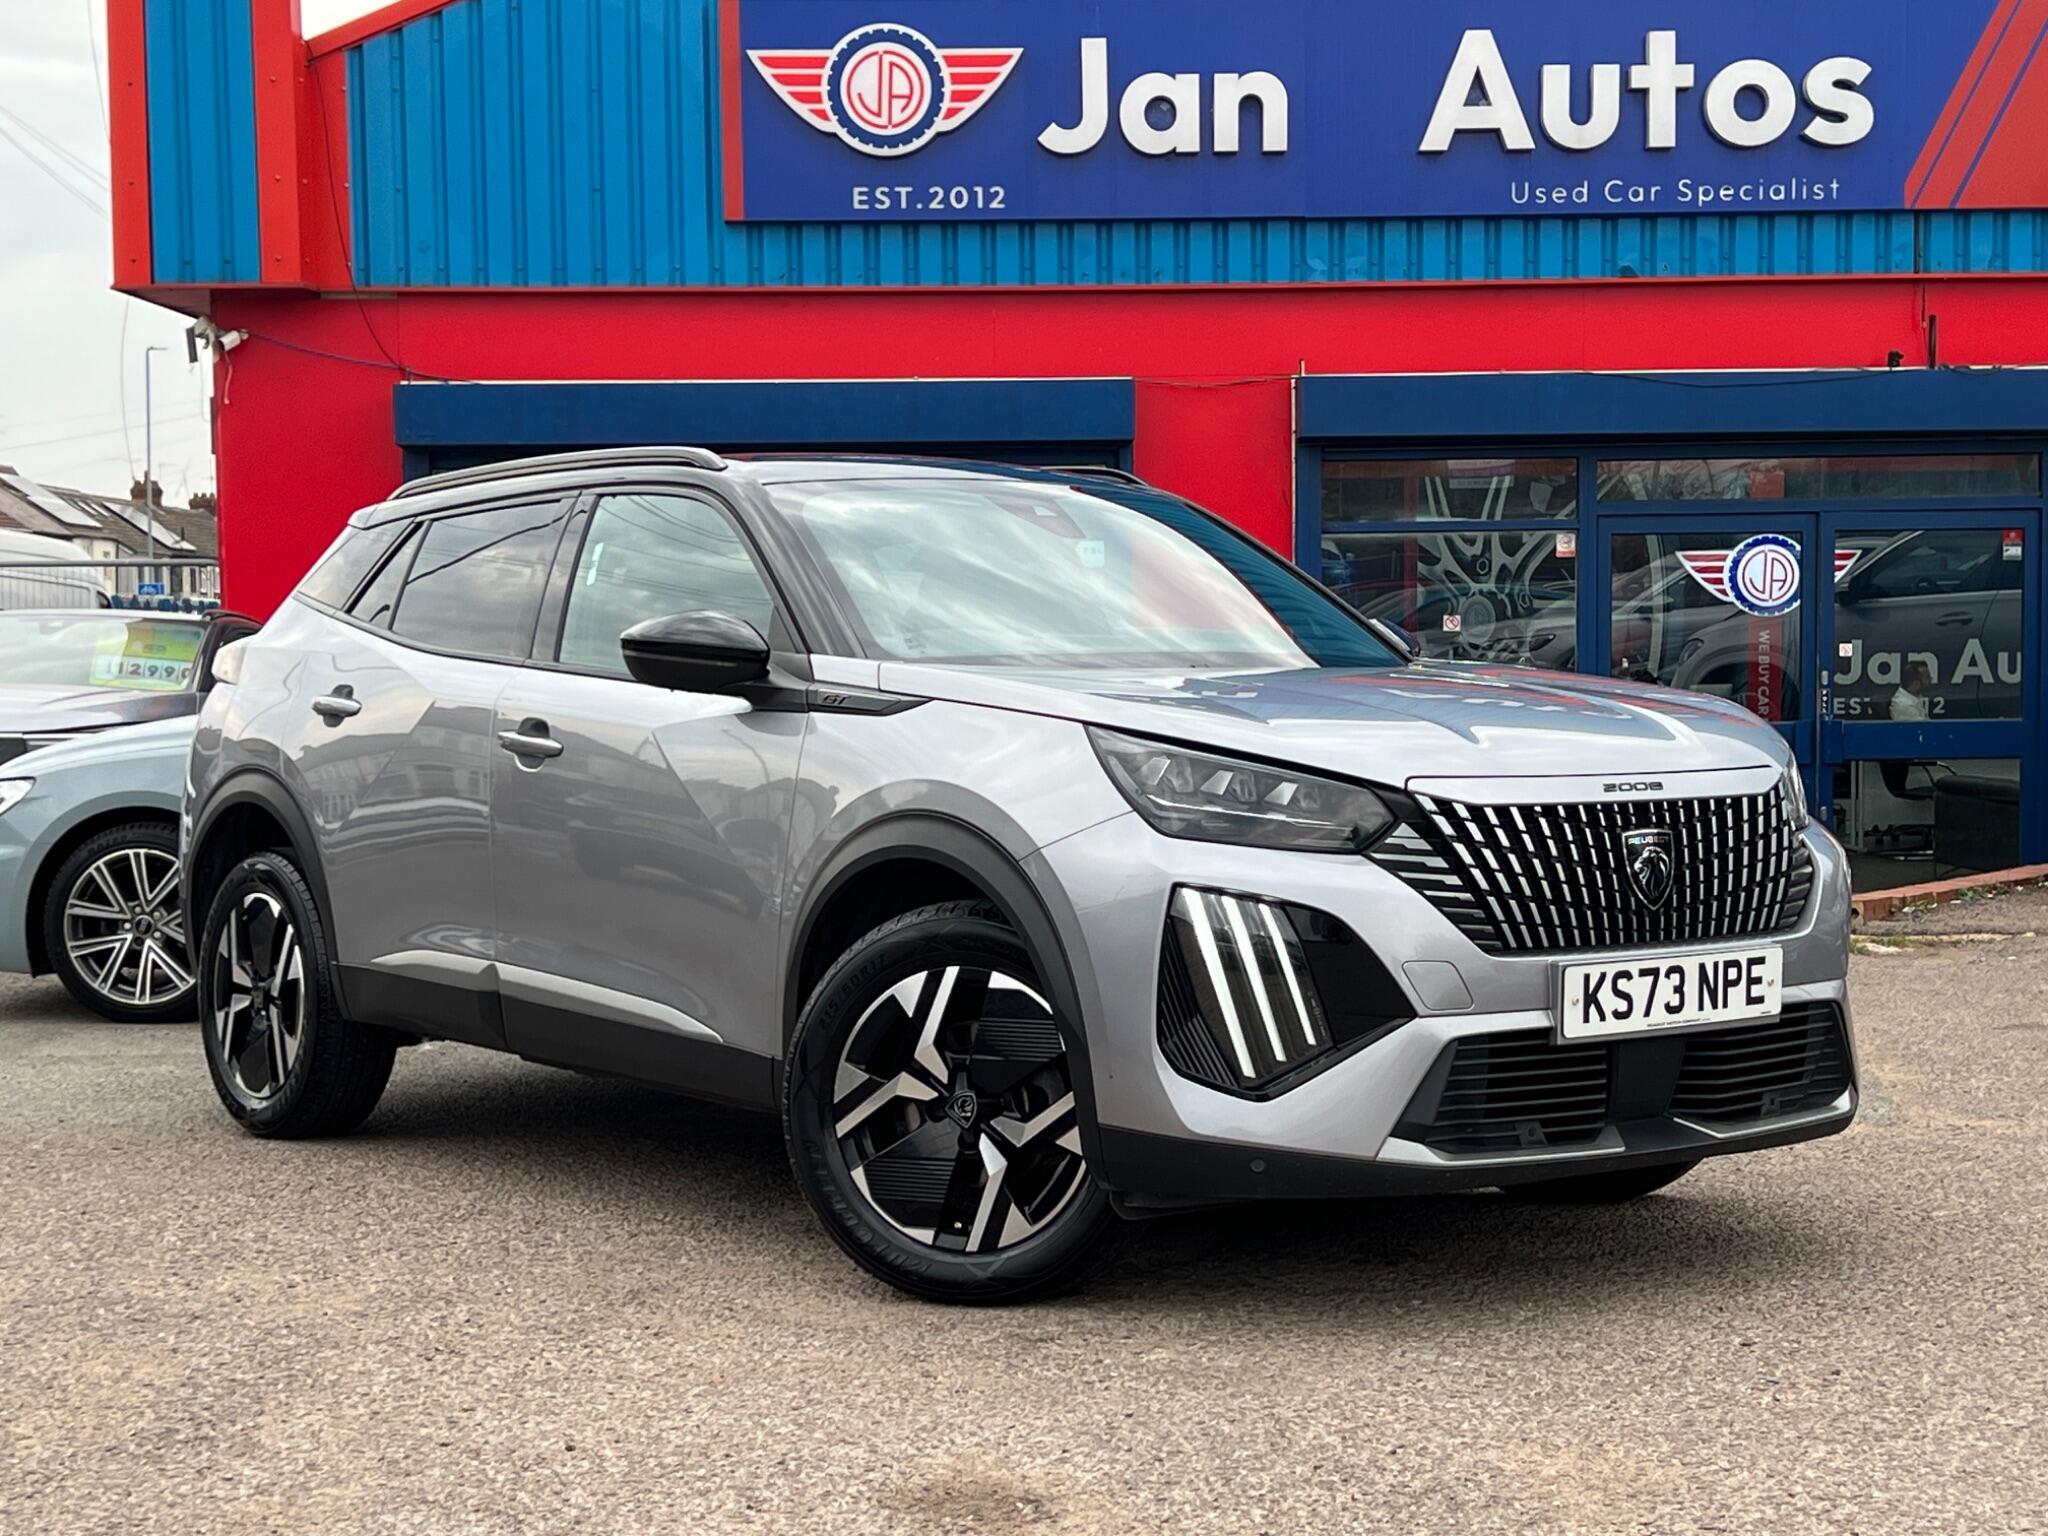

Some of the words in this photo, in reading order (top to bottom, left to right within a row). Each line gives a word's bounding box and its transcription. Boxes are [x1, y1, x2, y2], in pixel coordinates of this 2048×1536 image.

[1037, 36, 1289, 156] Jan
[1418, 28, 1876, 154] Autos
[852, 186, 1006, 210] EST.2012
[1510, 180, 1589, 205] Used
[1603, 179, 1661, 203] Car
[1676, 177, 1840, 207] Specialist
[1758, 629, 1770, 653] WE
[1758, 655, 1770, 684] BUY
[1833, 639, 1939, 686] Jan
[1757, 686, 1770, 721] CAR
[1602, 781, 1664, 793] 2008
[1582, 964, 1686, 1025] KS73
[1697, 955, 1767, 1012] NPE
